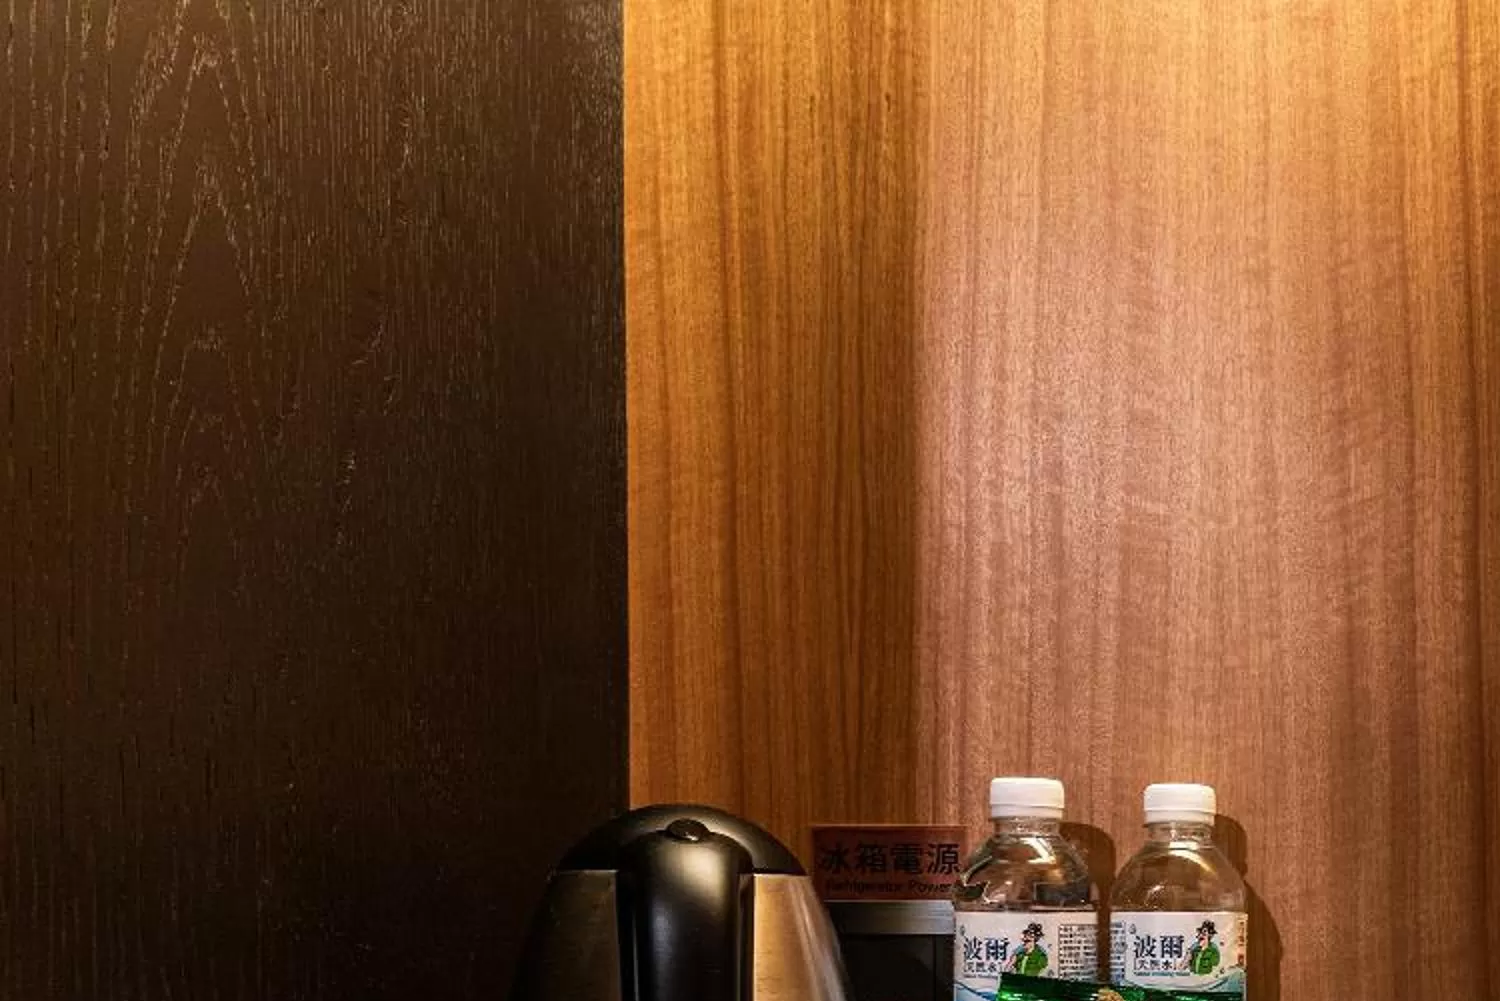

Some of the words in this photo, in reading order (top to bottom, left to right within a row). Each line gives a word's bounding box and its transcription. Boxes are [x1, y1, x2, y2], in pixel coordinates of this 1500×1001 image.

[819, 841, 961, 875] 冰箱電源
[964, 935, 1010, 961] 波爾
[1133, 935, 1184, 958] 波爾
